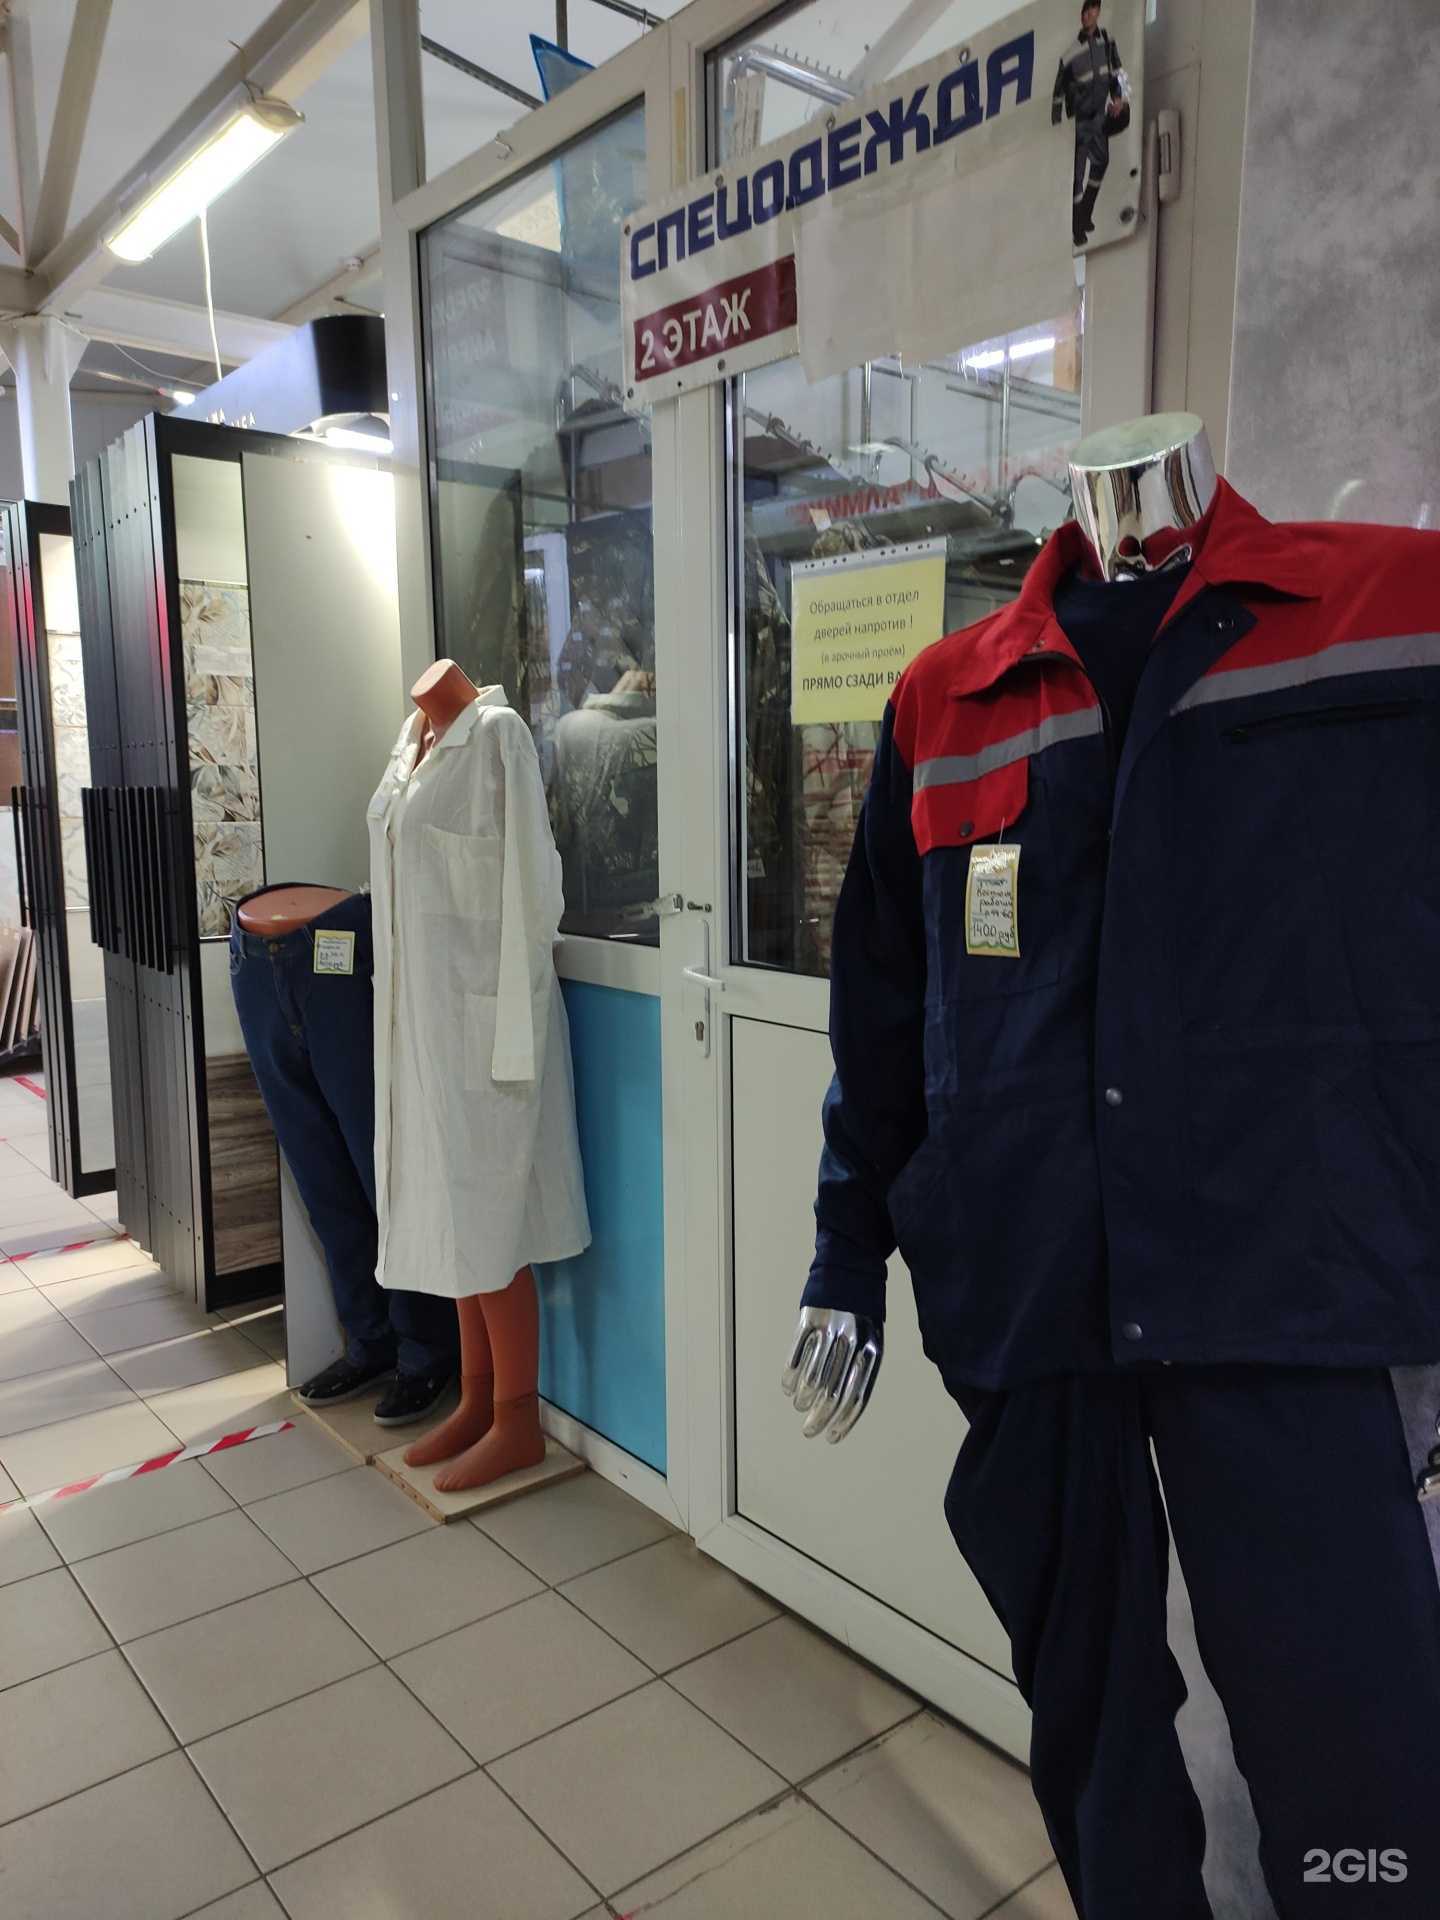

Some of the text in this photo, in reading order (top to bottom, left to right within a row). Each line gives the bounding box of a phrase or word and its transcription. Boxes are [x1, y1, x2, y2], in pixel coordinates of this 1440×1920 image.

[630, 30, 1035, 280] СПЕЦОДЕЖДА
[640, 288, 751, 370] 2 ЭТАЖ
[809, 590, 919, 615] Обращаться в отдел
[814, 622, 852, 641] дверей
[854, 618, 906, 635] напротив
[802, 671, 903, 691] ПРЯМО СЗАДИ ВА
[973, 922, 997, 938] 1400
